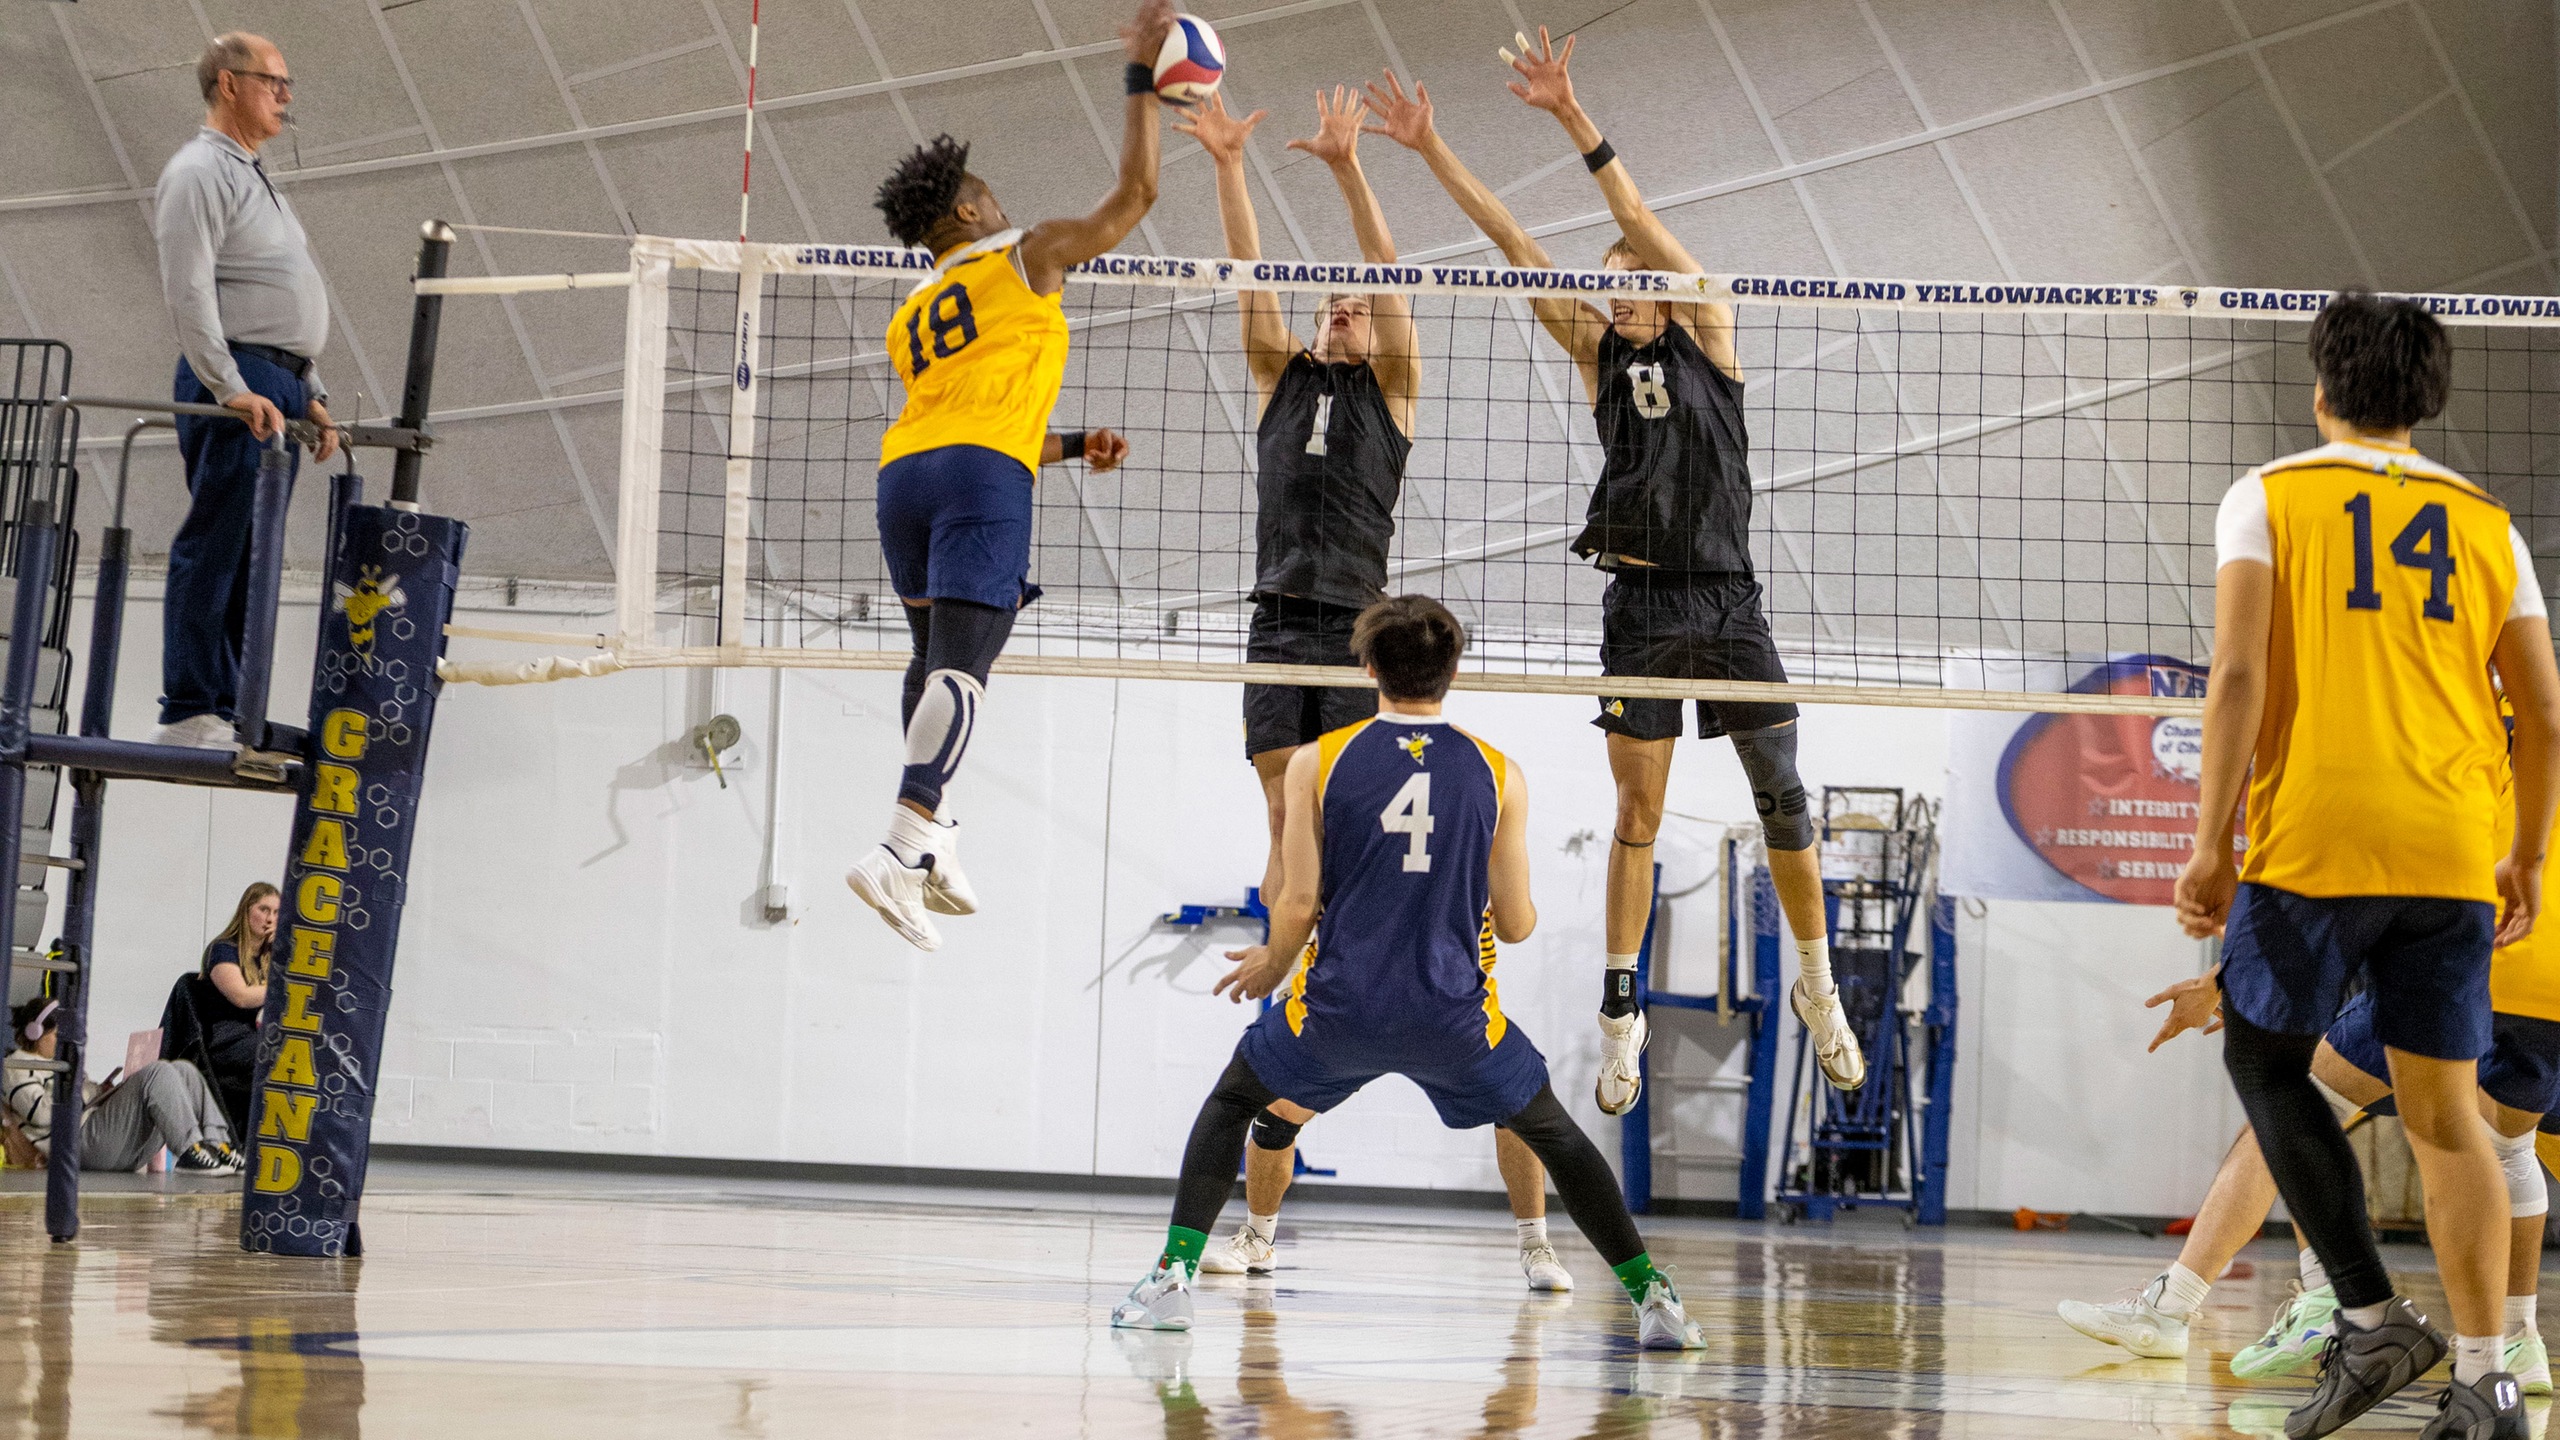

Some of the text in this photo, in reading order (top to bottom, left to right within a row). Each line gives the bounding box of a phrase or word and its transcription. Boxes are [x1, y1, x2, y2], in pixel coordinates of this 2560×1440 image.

[797, 248, 935, 270] GRACELAN
[1253, 263, 1669, 291] GRACELAND YELLOWJACKETS
[1731, 278, 2159, 307] GRACELAND YELLOWJACKETS
[904, 281, 979, 377] 18
[1626, 361, 1672, 420] 8
[1305, 393, 1333, 456] 1
[2344, 491, 2456, 623] 14
[1380, 772, 1435, 873] 4
[255, 708, 367, 1194] GRACELAND
